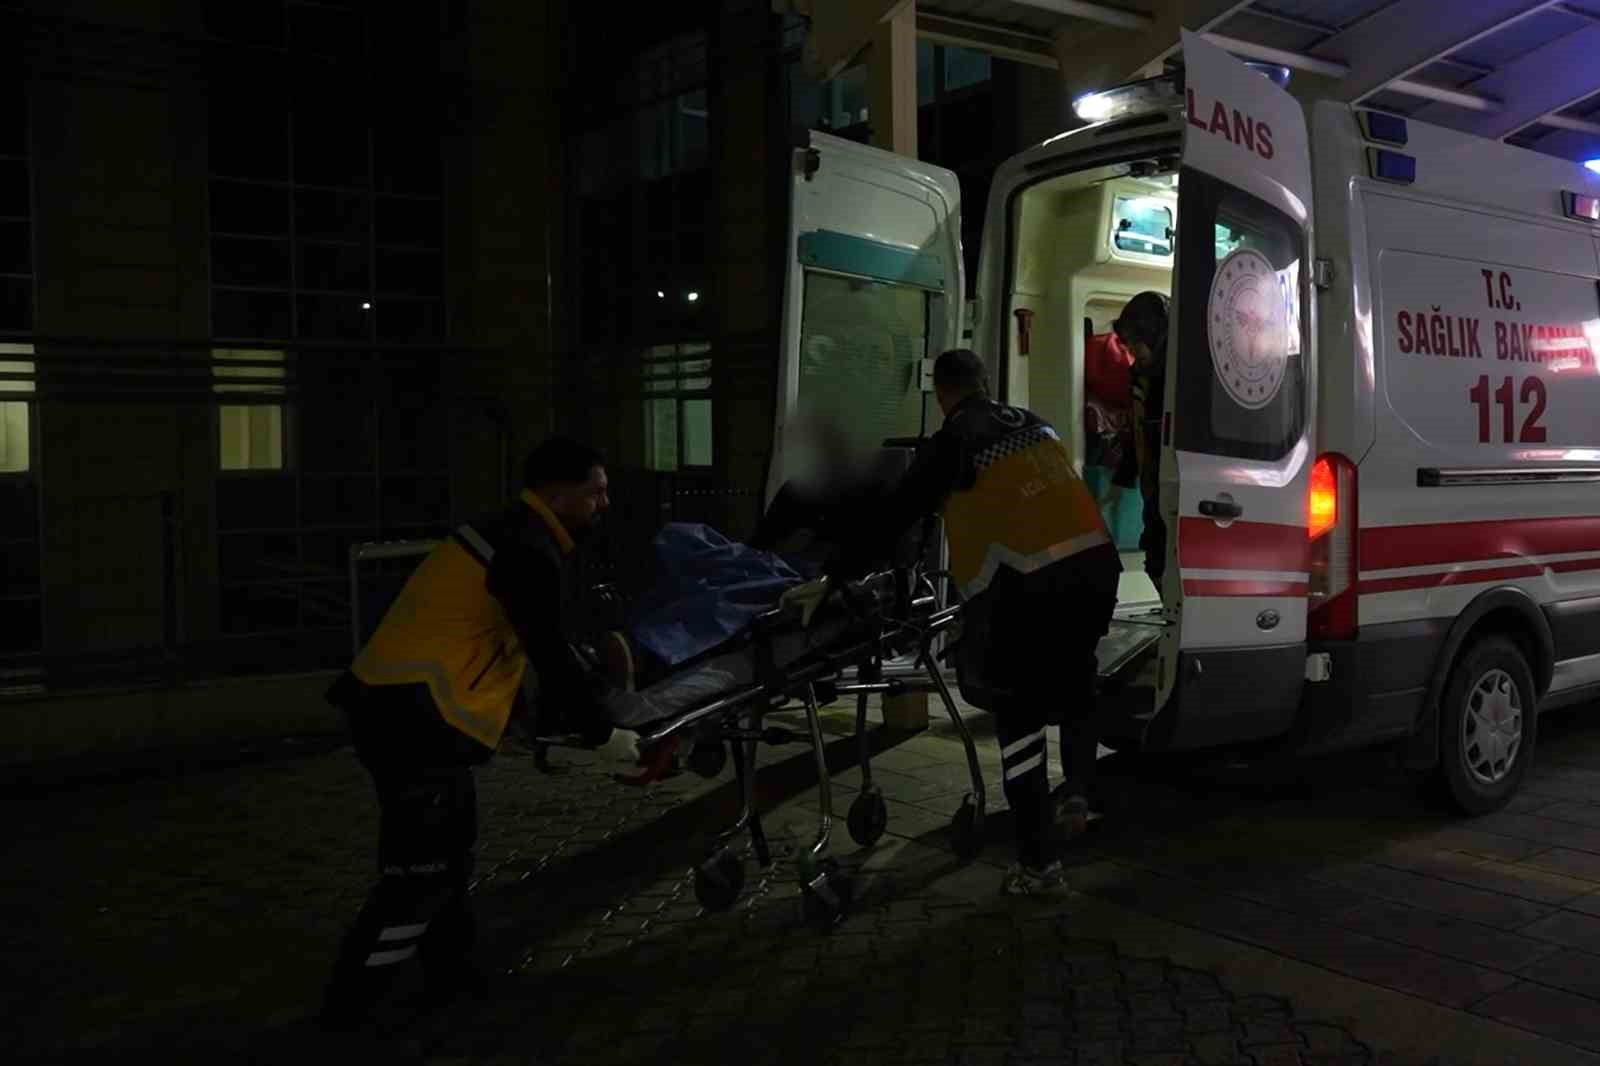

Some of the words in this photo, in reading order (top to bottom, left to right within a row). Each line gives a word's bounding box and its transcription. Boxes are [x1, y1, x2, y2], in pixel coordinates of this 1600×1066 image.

[1186, 87, 1274, 160] LANS
[1481, 268, 1521, 311] T.C.
[1397, 304, 1483, 359] SAĞLIK
[1469, 374, 1547, 443] 112
